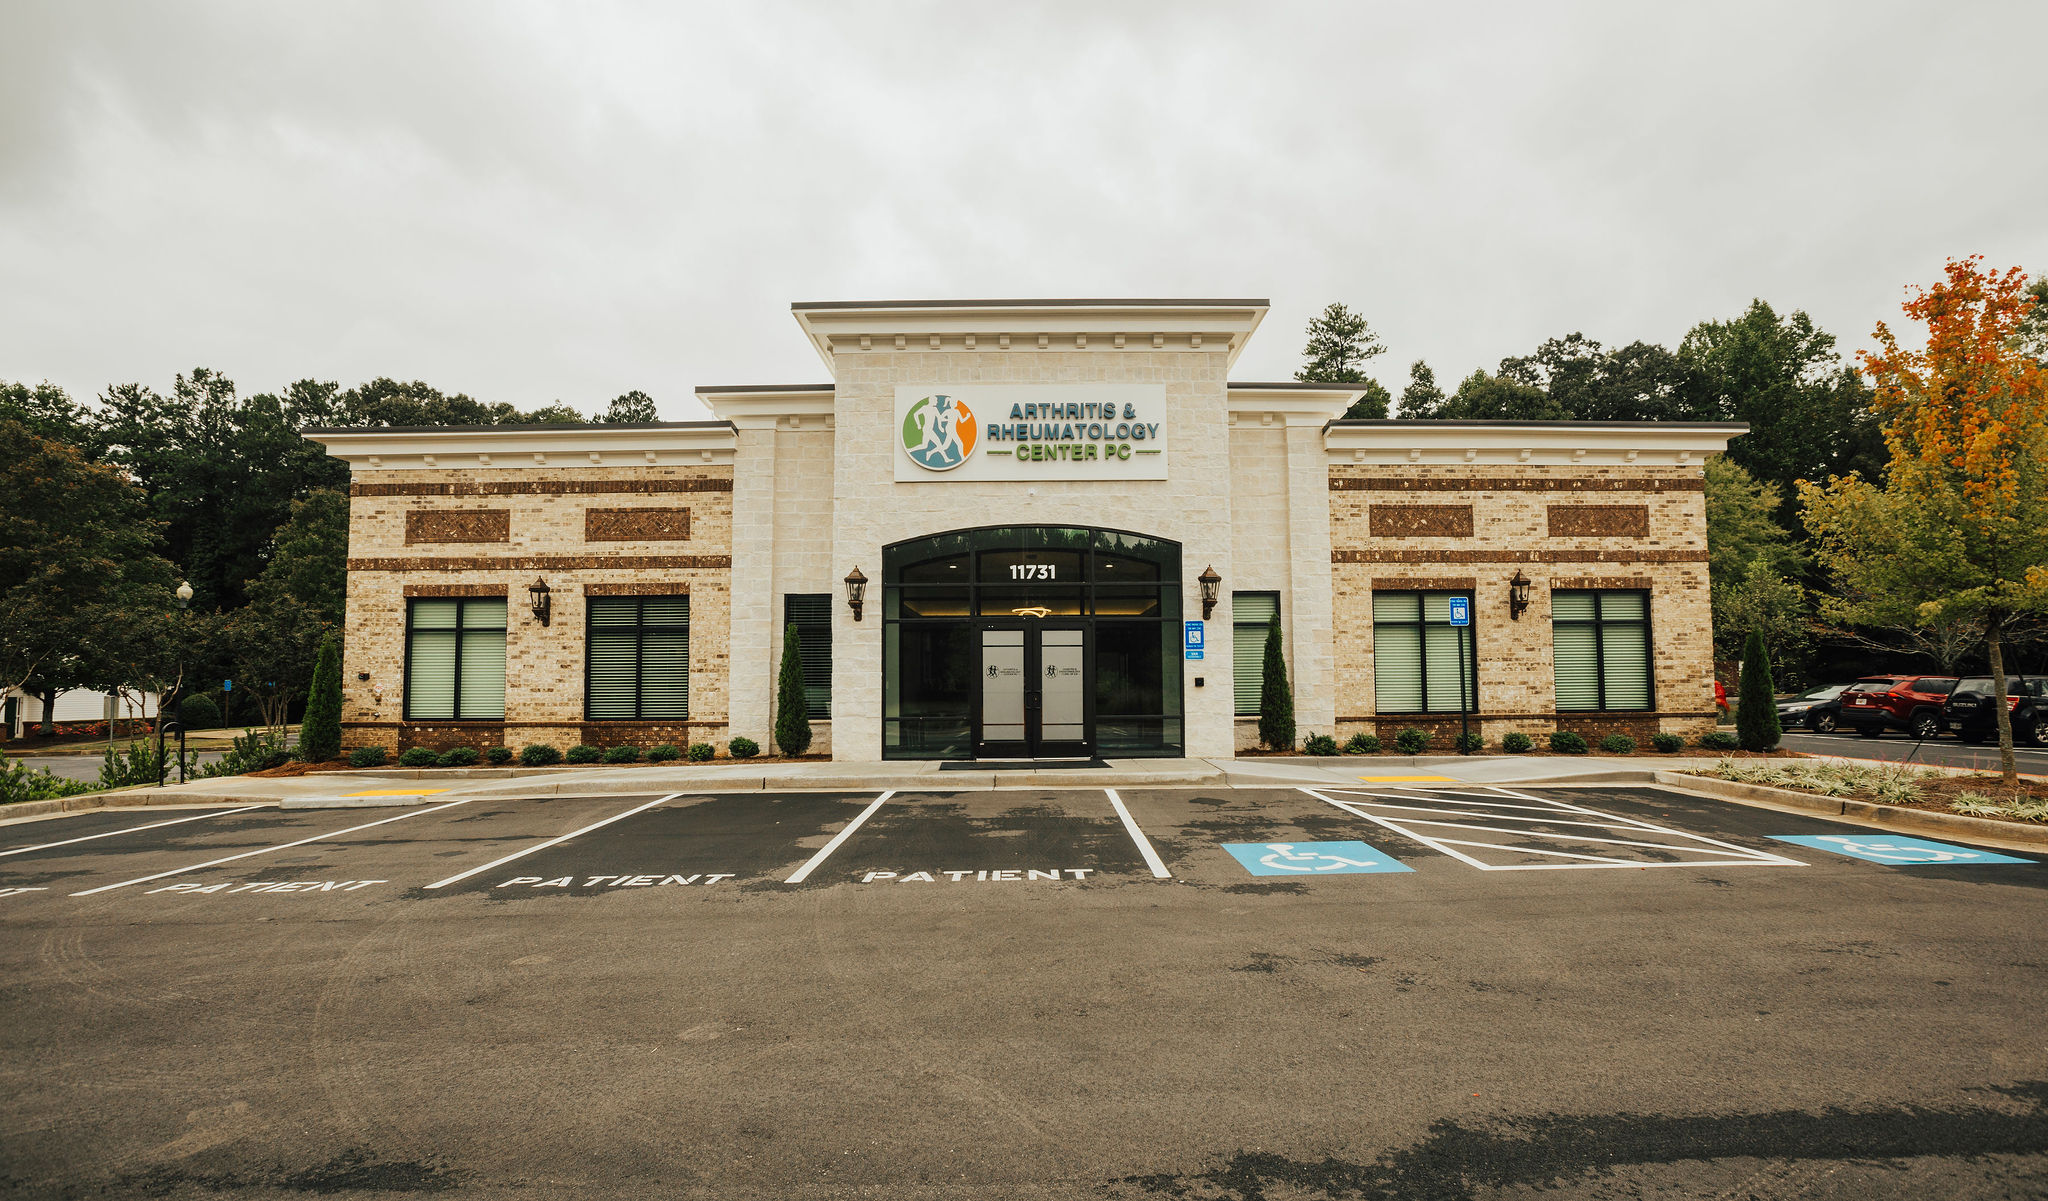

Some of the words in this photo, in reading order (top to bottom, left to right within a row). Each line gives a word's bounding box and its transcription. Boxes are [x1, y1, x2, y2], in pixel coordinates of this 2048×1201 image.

[1009, 402, 1116, 420] ARTHRITIS
[1123, 402, 1136, 419] &
[987, 422, 1160, 441] RHEUMATOLOGY
[1016, 443, 1098, 462] CENTER
[1104, 443, 1132, 460] PC
[1009, 564, 1056, 580] 11731
[495, 873, 736, 888] PATIENT
[860, 868, 1094, 883] PATIENT
[144, 880, 389, 894] PATIENT
